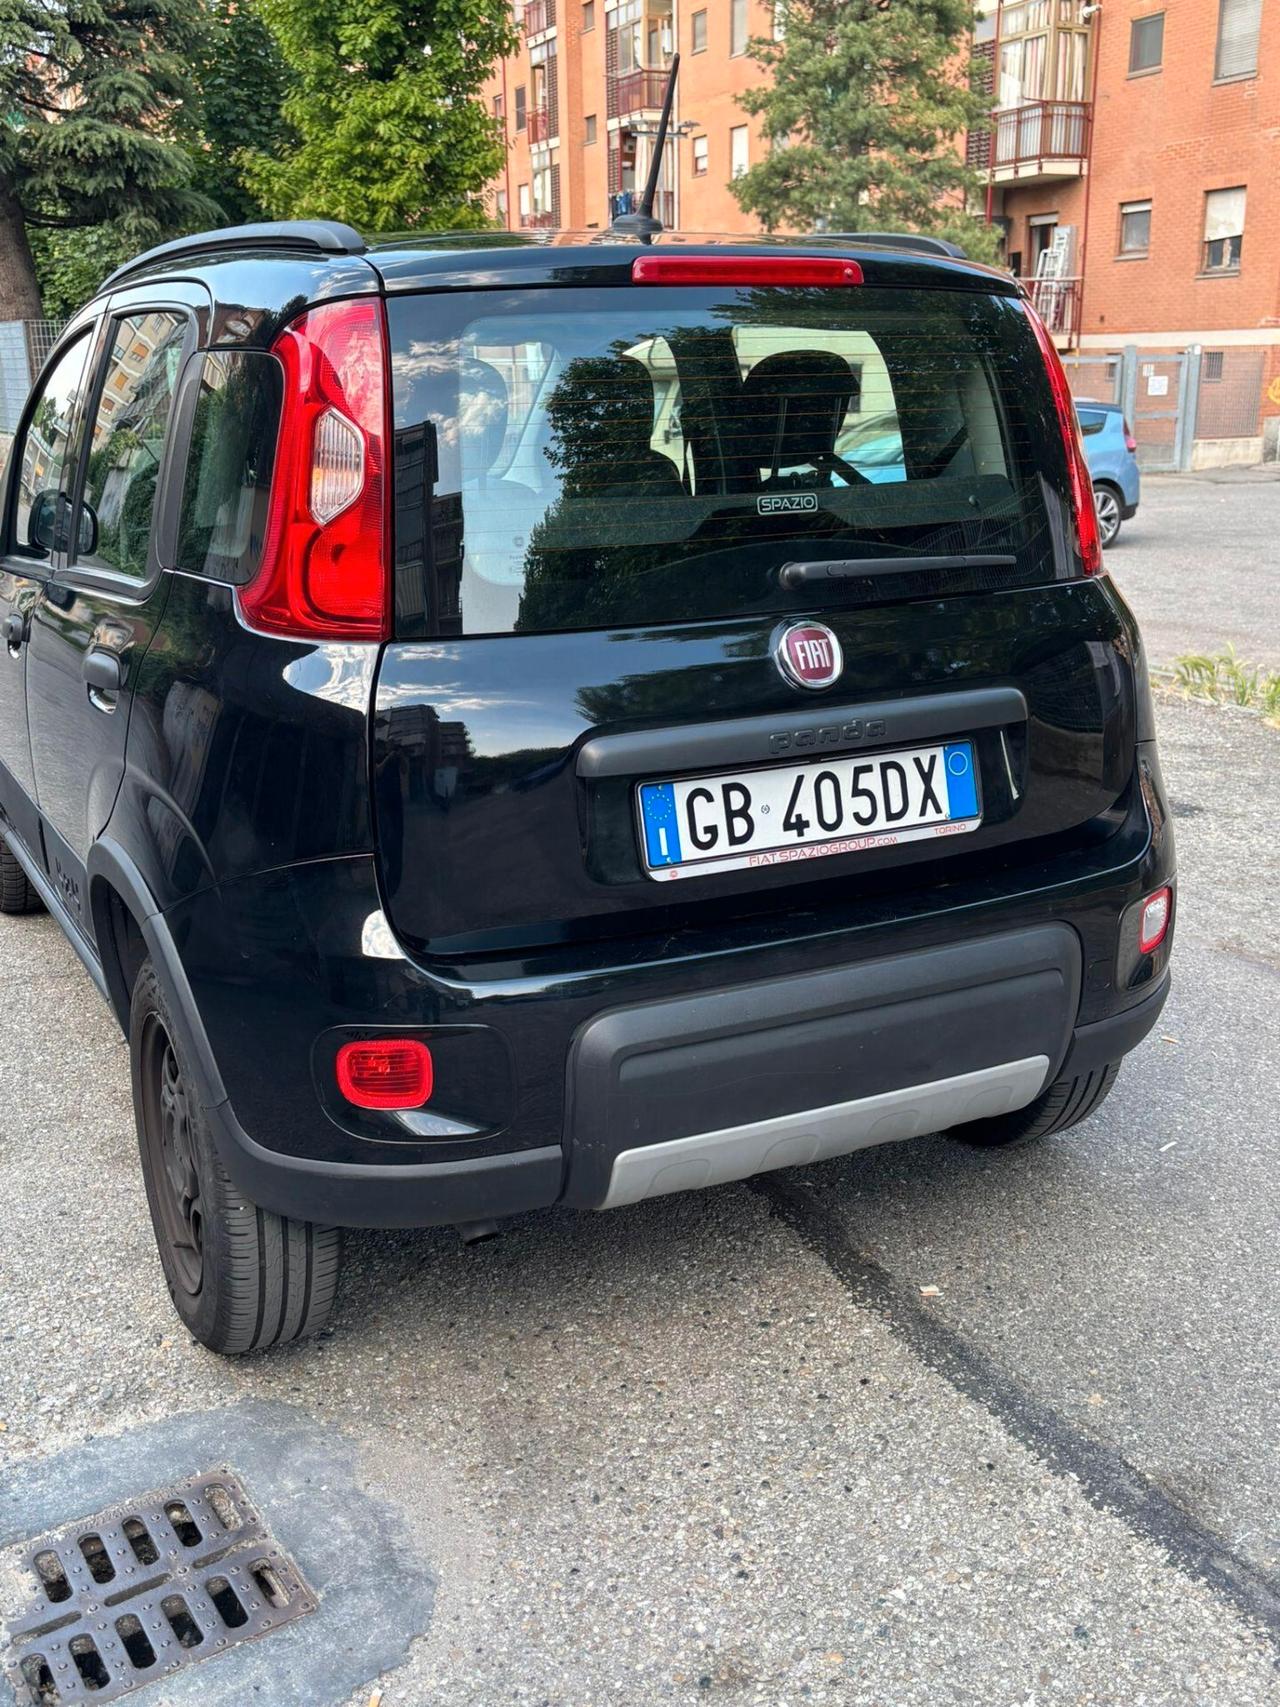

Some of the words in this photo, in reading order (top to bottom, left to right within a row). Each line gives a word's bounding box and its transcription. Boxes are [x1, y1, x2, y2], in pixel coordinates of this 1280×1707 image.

[761, 496, 815, 511] SPAZIO
[795, 638, 831, 670] FIAT
[769, 718, 887, 755] panda
[686, 782, 755, 851] GB
[782, 754, 943, 837] 405DX
[933, 823, 967, 835] TORINO
